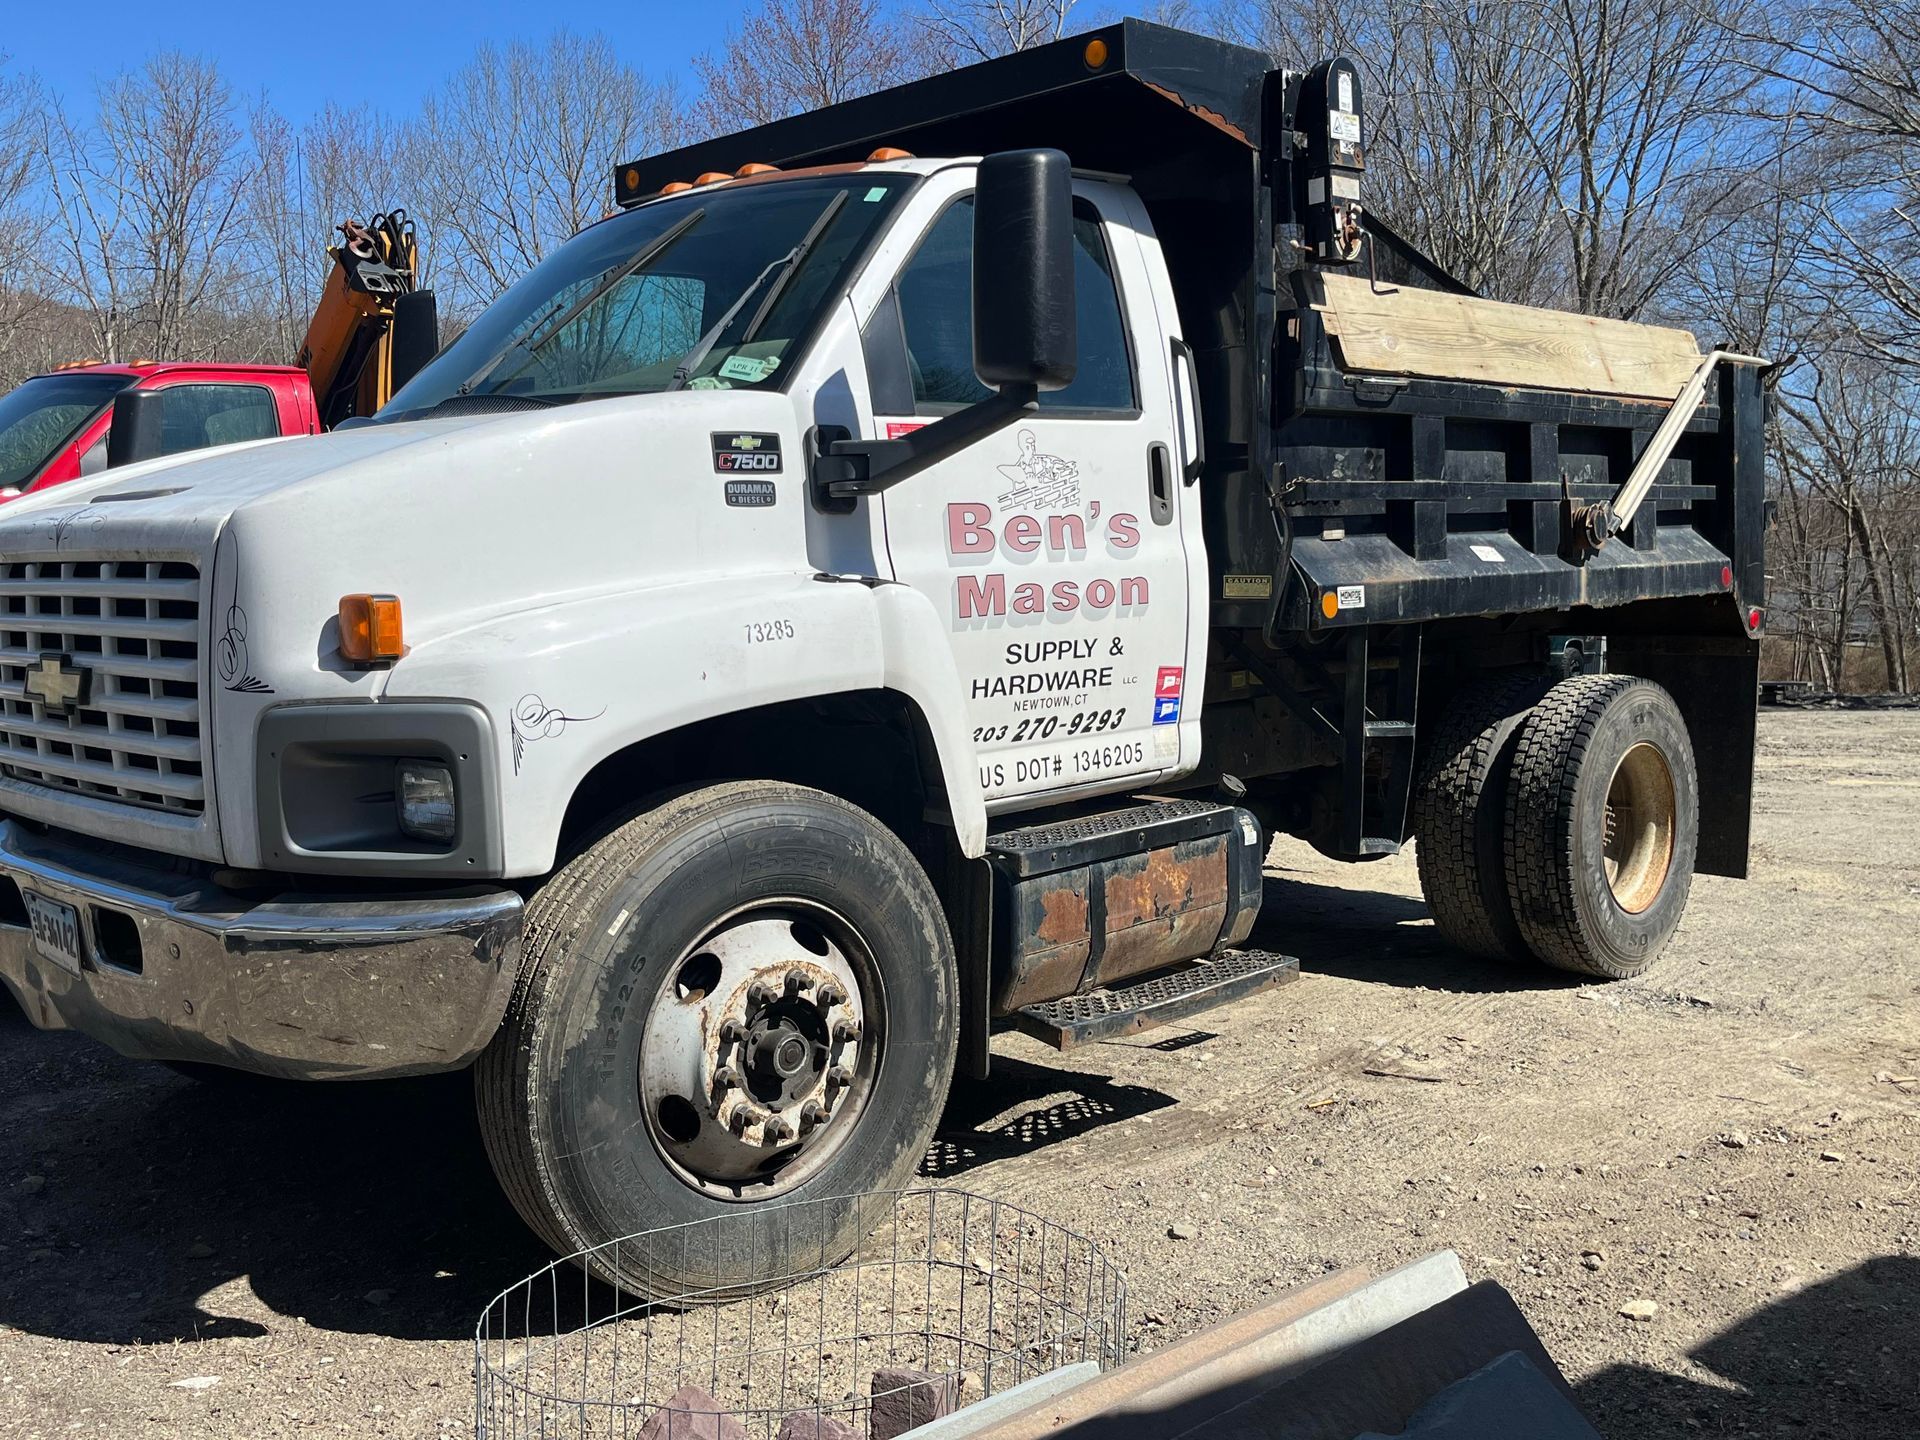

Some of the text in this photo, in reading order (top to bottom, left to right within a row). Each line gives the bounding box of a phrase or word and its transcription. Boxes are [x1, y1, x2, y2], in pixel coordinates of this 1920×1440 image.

[719, 454, 778, 469] C7500
[727, 483, 774, 494] DURAMAX
[738, 496, 766, 504] DIESEL
[947, 500, 1141, 554] Ben's
[957, 573, 1149, 619] Mason
[744, 619, 795, 644] 73285
[1006, 636, 1124, 664] SUPPLY &
[971, 667, 1138, 699] HARDWARE LLC
[973, 725, 1008, 742] 203
[1011, 707, 1127, 743] 270-9293
[980, 764, 1005, 788] US
[1016, 754, 1062, 783] DOT#
[1073, 742, 1143, 773] 1346205
